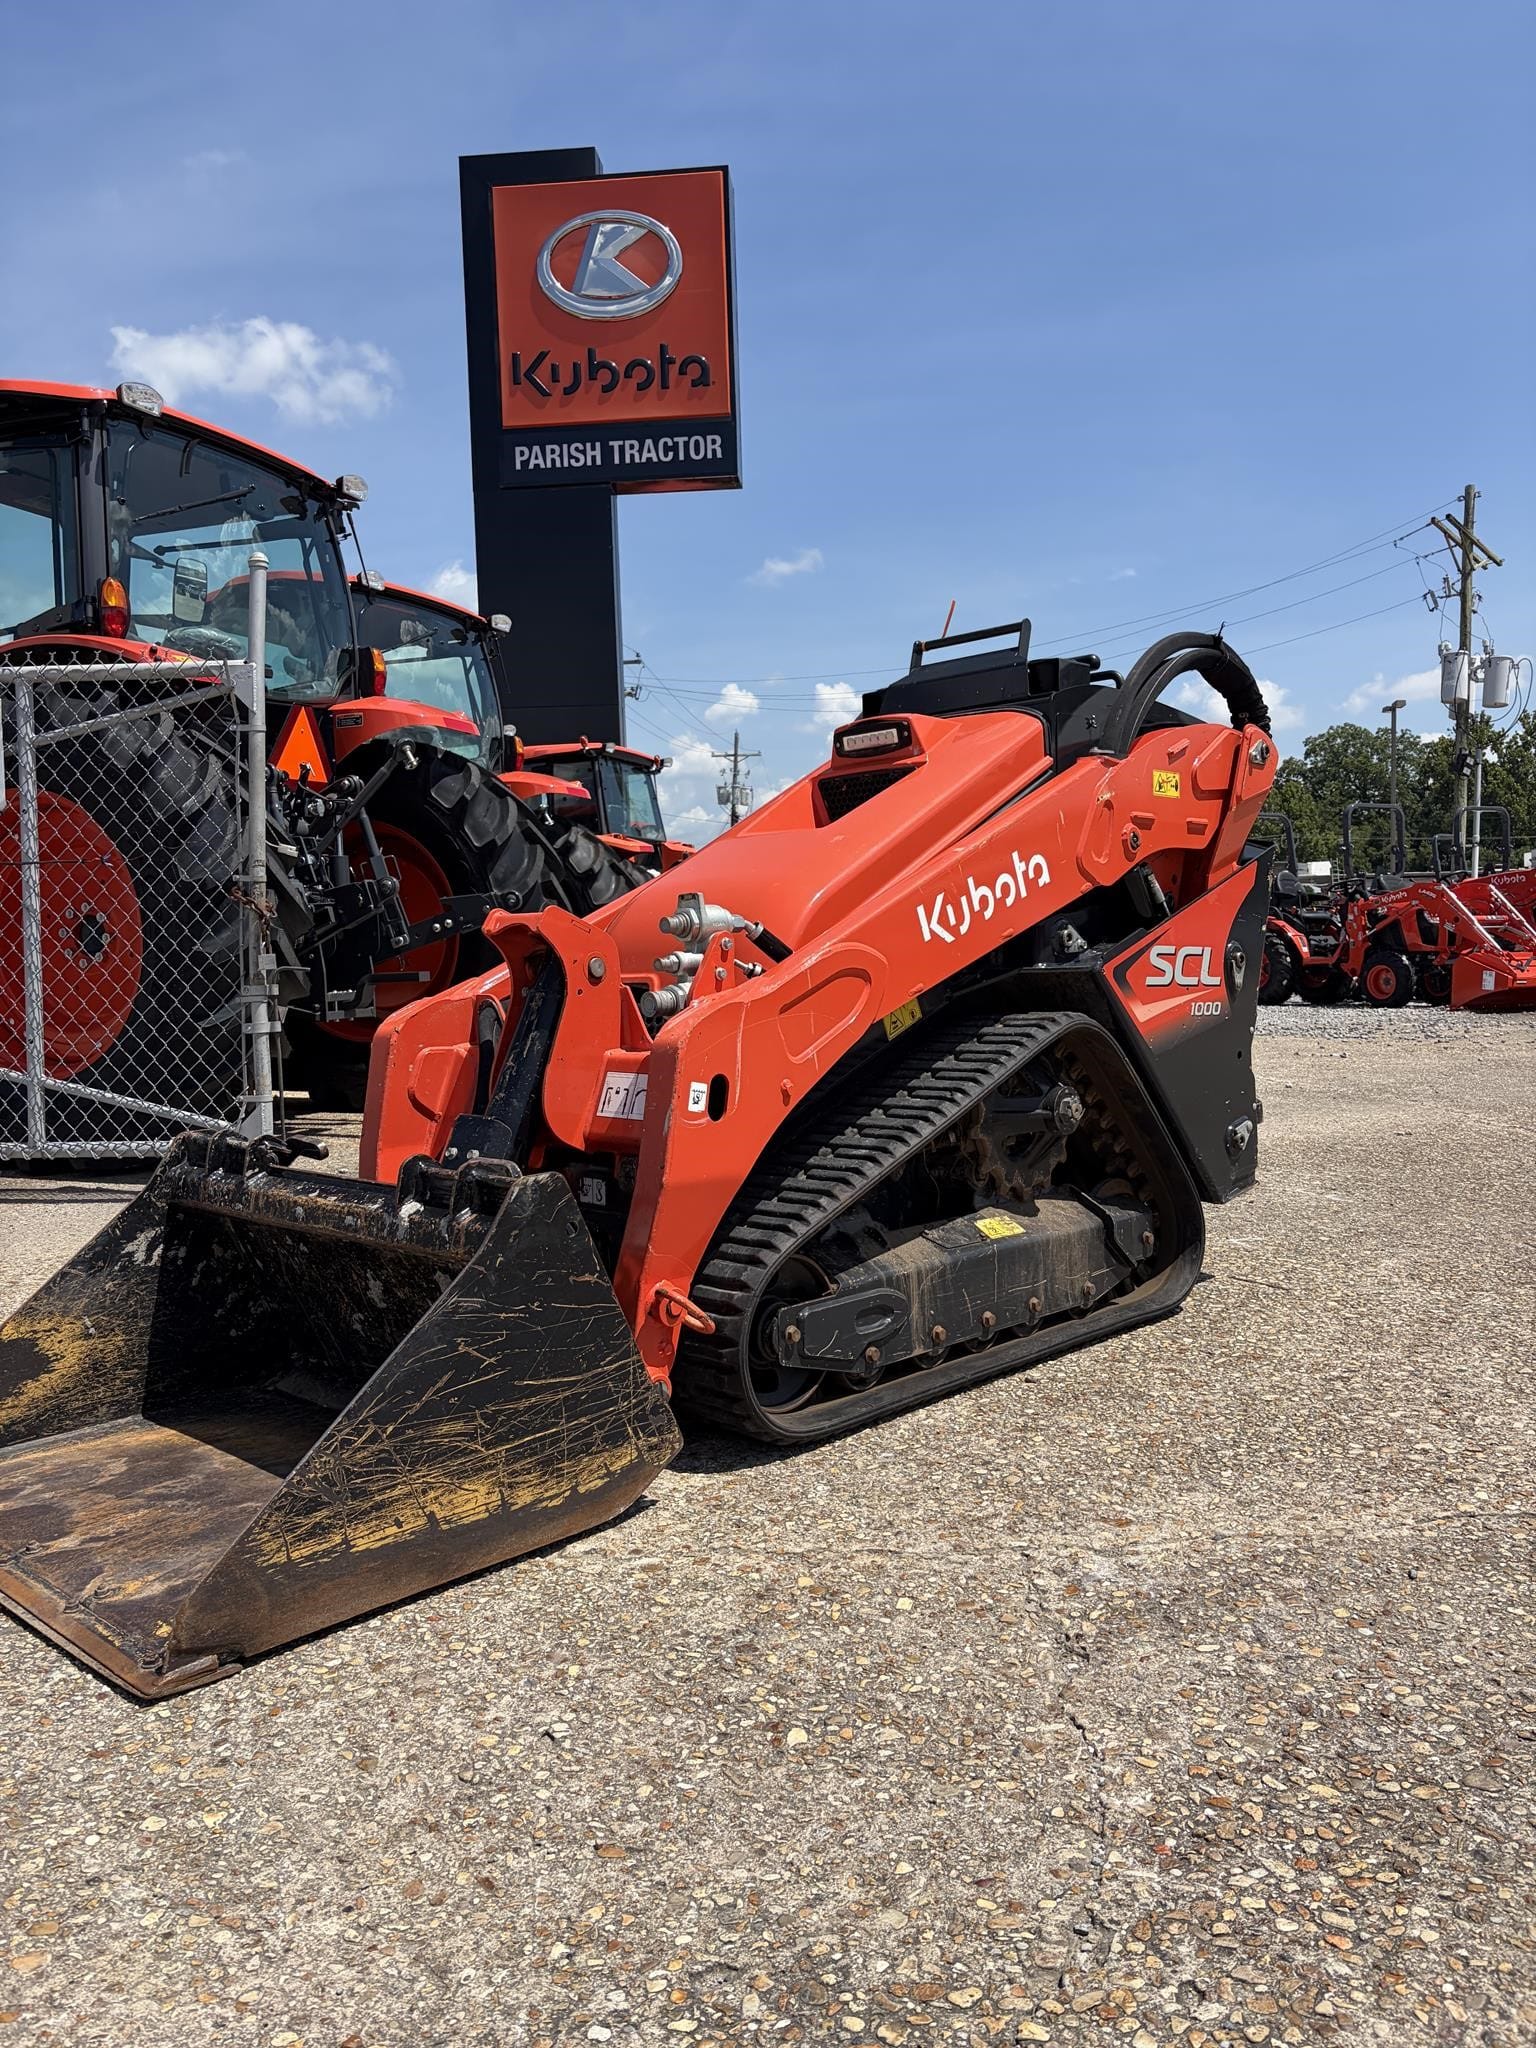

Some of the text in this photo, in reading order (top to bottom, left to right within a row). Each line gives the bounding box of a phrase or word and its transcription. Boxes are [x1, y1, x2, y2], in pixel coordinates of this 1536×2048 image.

[512, 343, 711, 397] Kubota
[514, 434, 723, 470] PARISH TRACTOR
[916, 850, 1051, 944] Kubota
[1381, 890, 1408, 904] Kubota
[1490, 873, 1526, 885] Kubota
[1145, 945, 1222, 987] SCL
[1190, 1002, 1222, 1016] 1000
